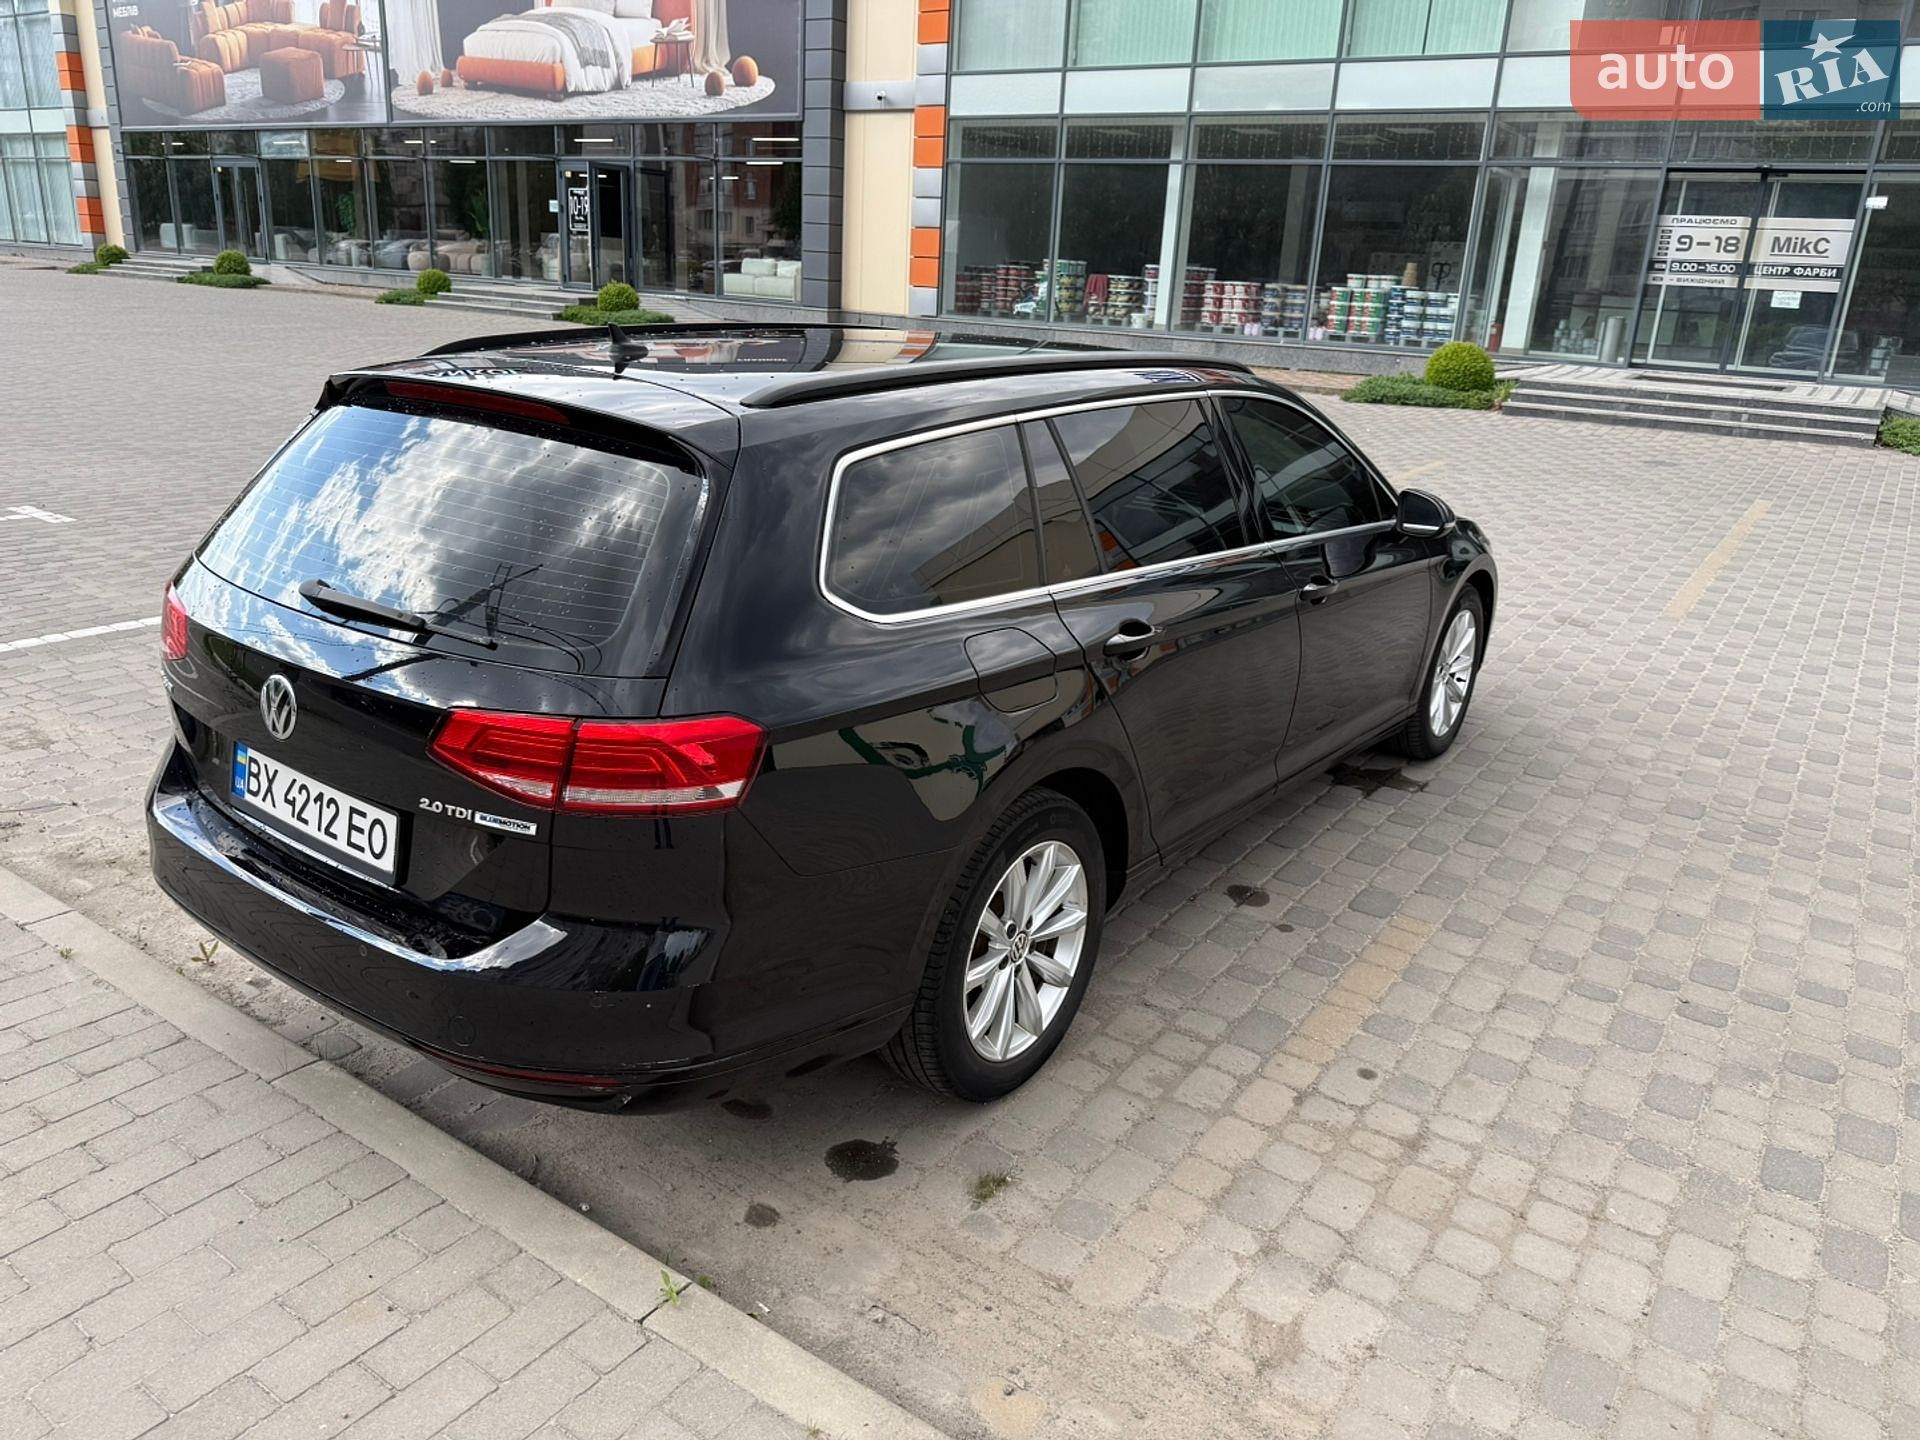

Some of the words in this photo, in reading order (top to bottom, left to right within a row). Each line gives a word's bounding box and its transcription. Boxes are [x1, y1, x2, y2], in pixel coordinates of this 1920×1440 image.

[1770, 235, 1831, 255] MikC
[1754, 265, 1790, 276] ЦЕНТР
[1793, 266, 1837, 277] ФАРБИ
[234, 776, 245, 791] UA
[247, 756, 278, 809] BX
[284, 778, 340, 840] 4212
[347, 805, 388, 860] EO
[445, 804, 472, 820] TDI
